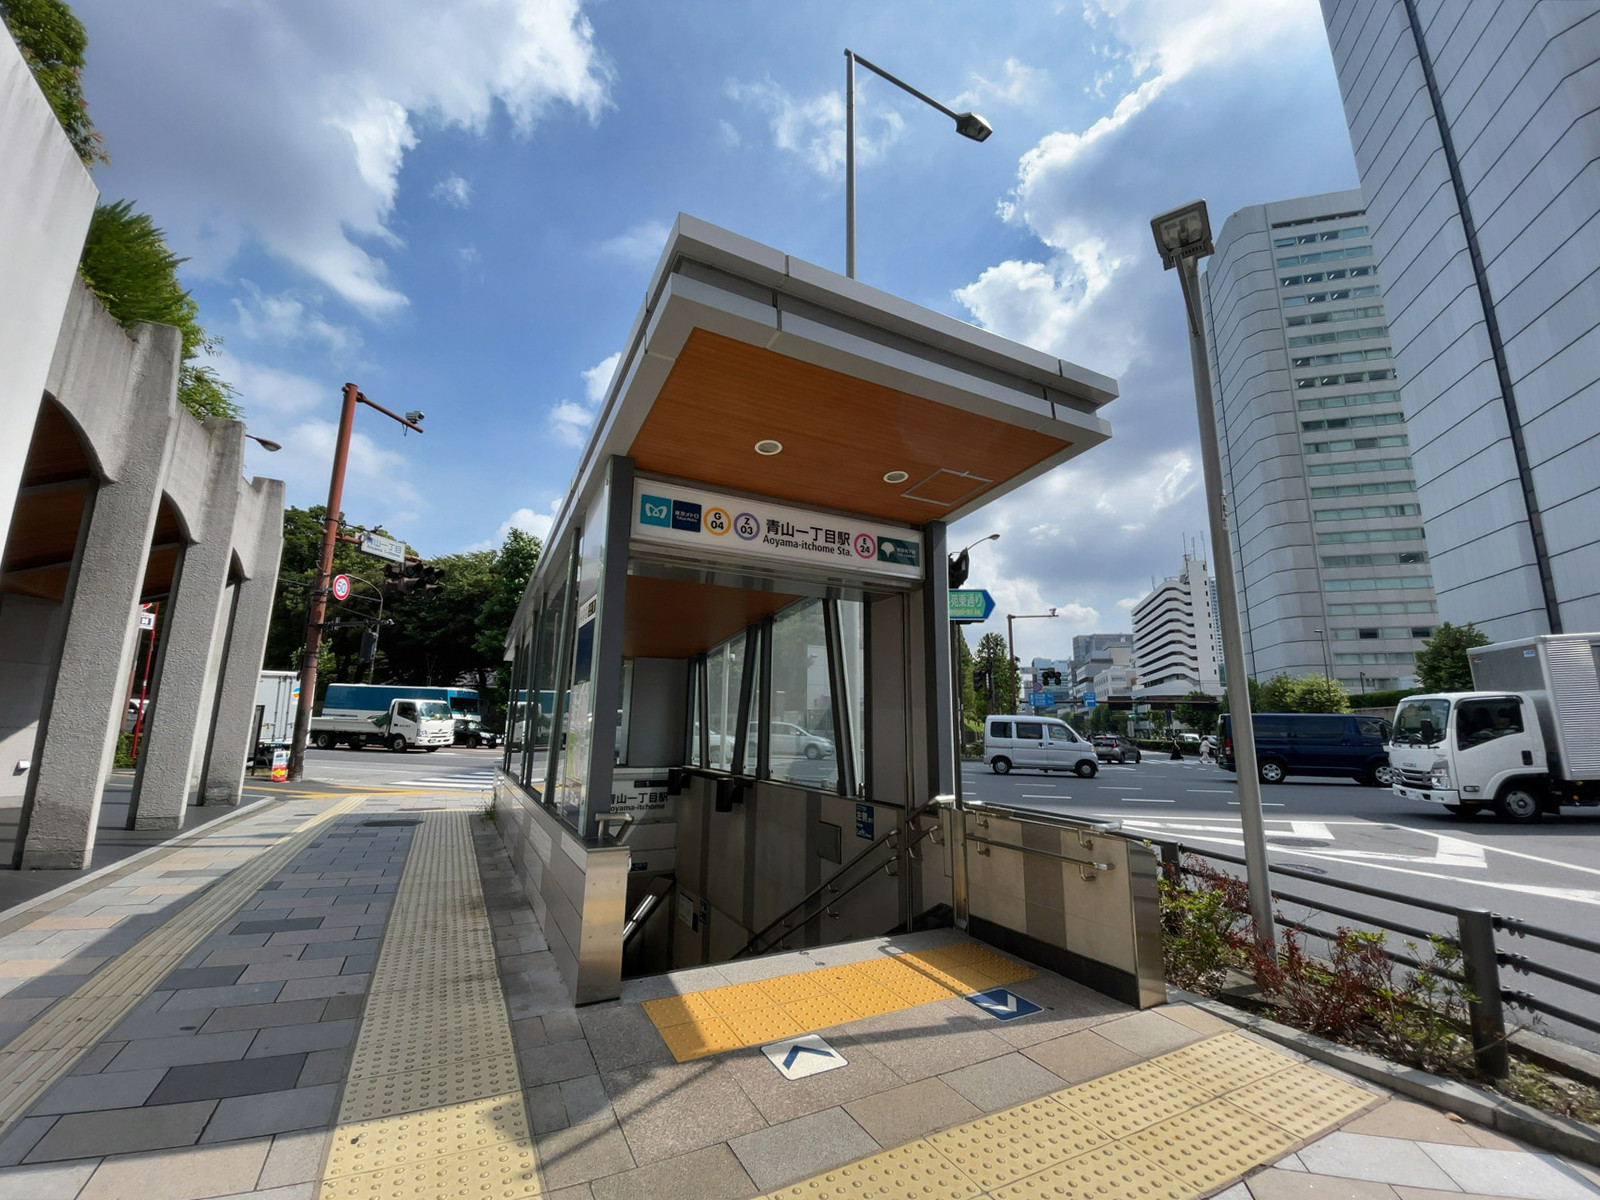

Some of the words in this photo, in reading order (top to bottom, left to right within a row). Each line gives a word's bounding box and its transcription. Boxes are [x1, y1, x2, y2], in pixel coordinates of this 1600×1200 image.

[714, 512, 722, 520] G
[710, 520, 724, 531] 04
[744, 517, 751, 526] Z
[740, 525, 753, 535] 03
[765, 518, 850, 547] 青山一丁目駅
[763, 534, 835, 554] Aoyama-itchome
[837, 546, 853, 557] Sta.
[862, 537, 868, 545] E
[860, 545, 870, 554] 24
[337, 581, 347, 594] 50
[951, 594, 983, 607] 苑東通り
[610, 803, 666, 812] oyama-itchome
